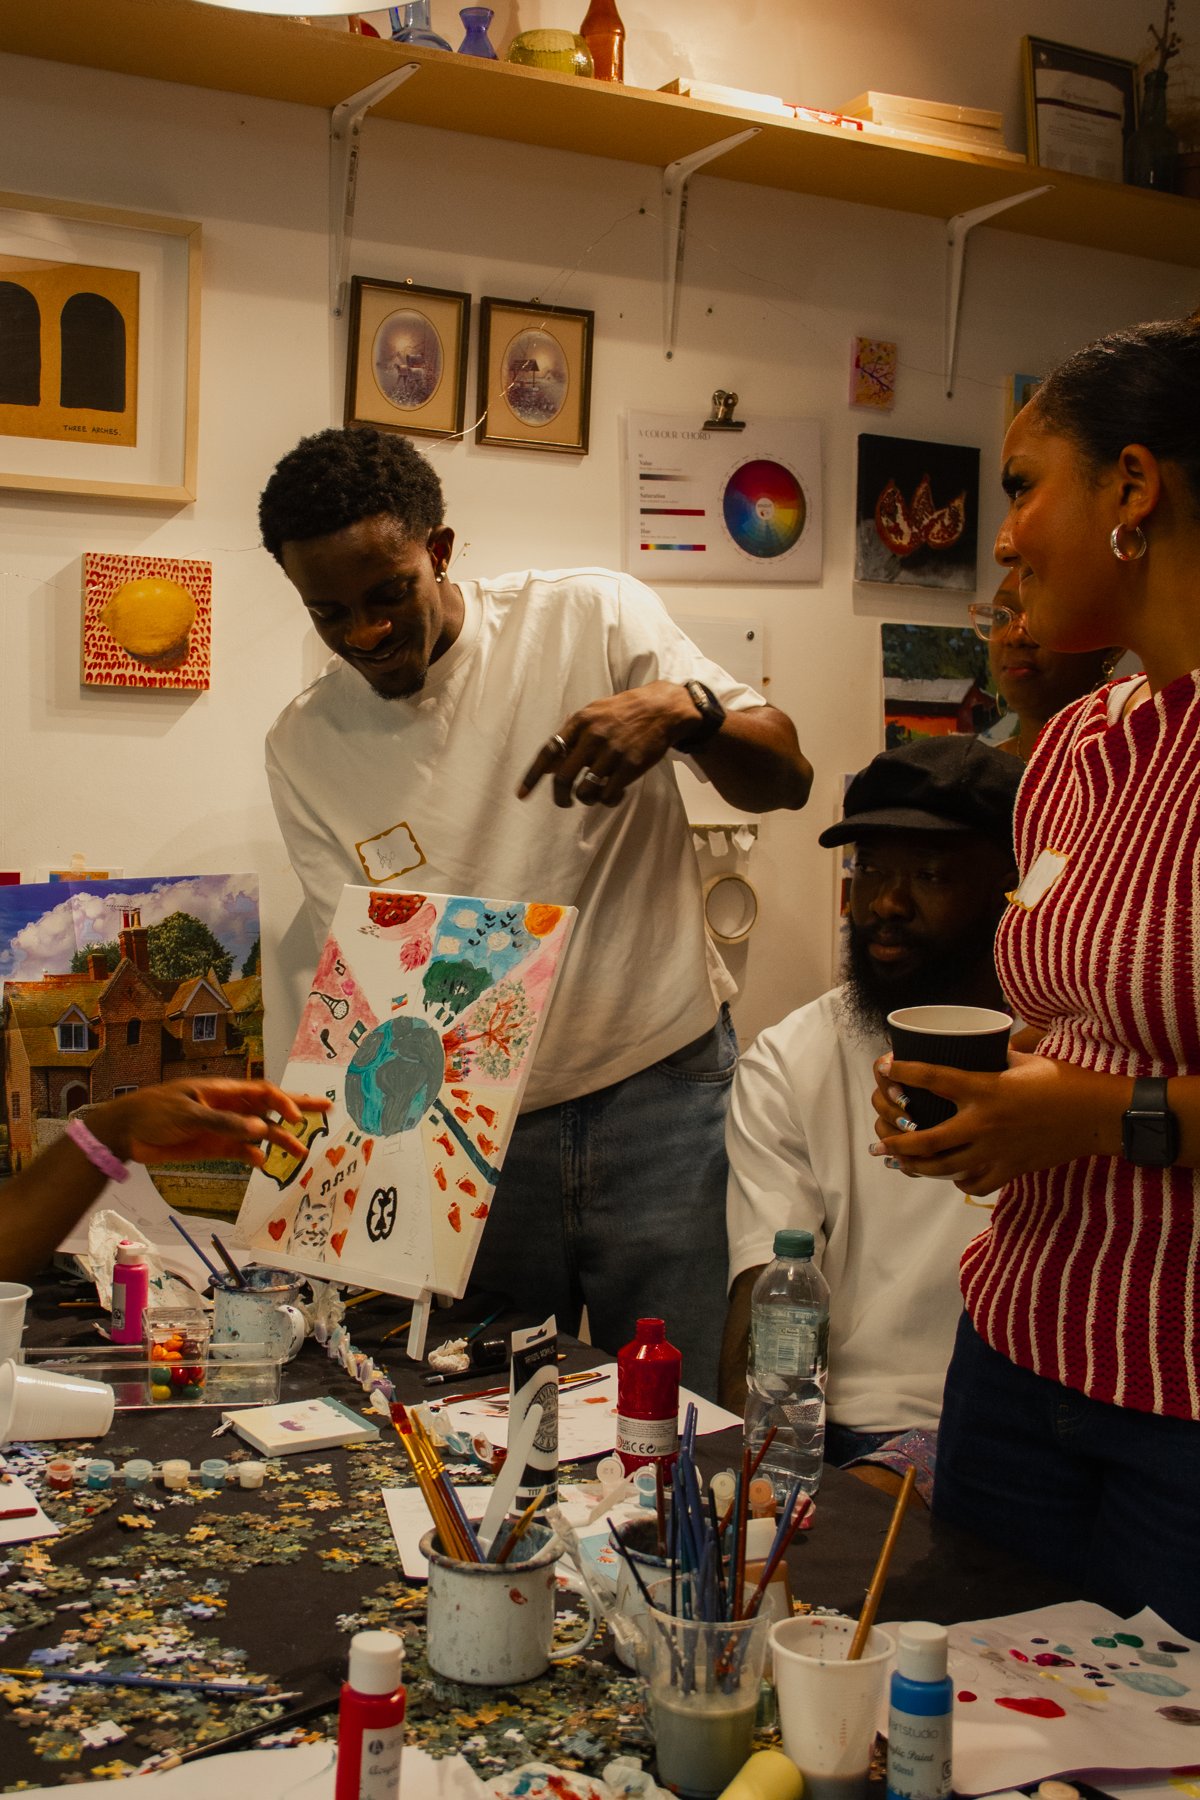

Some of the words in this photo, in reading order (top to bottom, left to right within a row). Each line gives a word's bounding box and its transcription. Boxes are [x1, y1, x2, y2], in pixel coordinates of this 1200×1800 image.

[63, 424, 88, 433] THREE
[91, 426, 122, 436] ARCHES.
[645, 430, 678, 440] COLOUR
[907, 1751, 935, 1762] Paint
